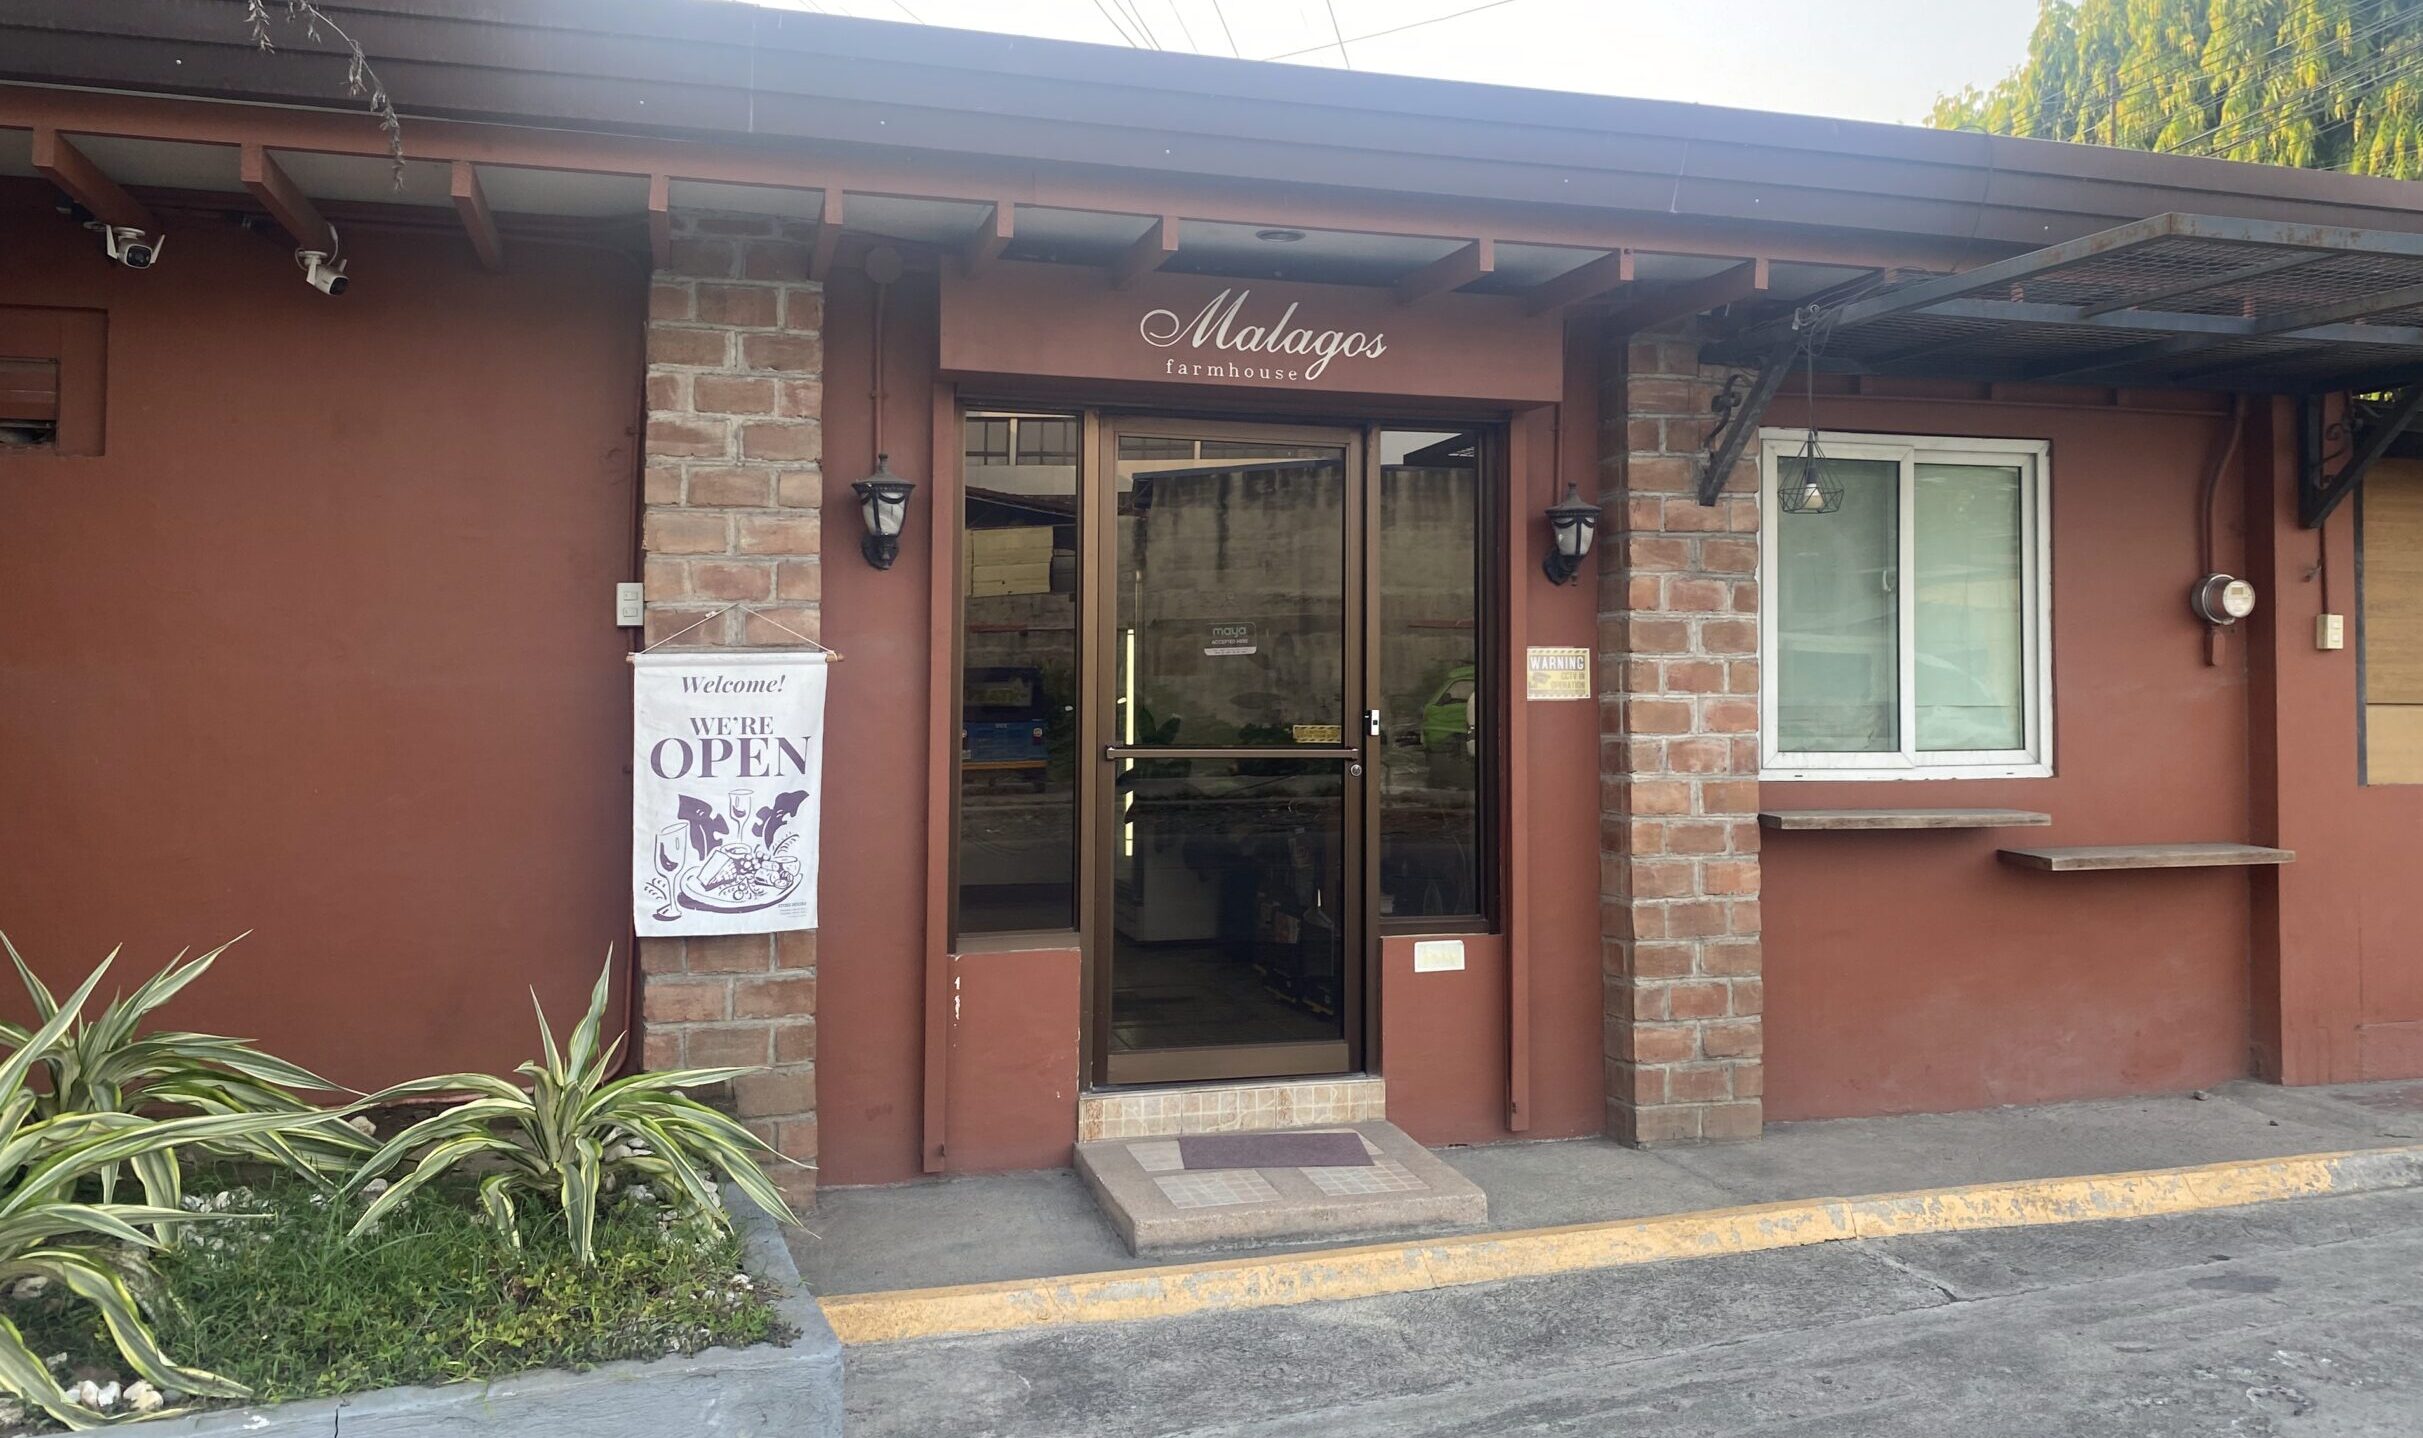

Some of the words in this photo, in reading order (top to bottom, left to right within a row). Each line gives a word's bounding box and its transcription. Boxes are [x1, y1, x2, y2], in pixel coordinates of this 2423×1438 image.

[1140, 288, 1387, 381] Malagos
[1165, 358, 1298, 381] farmhouse
[1212, 626, 1247, 638] maya
[1530, 656, 1585, 670] WARNING
[682, 674, 786, 694] Welcome!
[689, 716, 775, 735] WE'RE
[650, 735, 812, 780] OPEN
